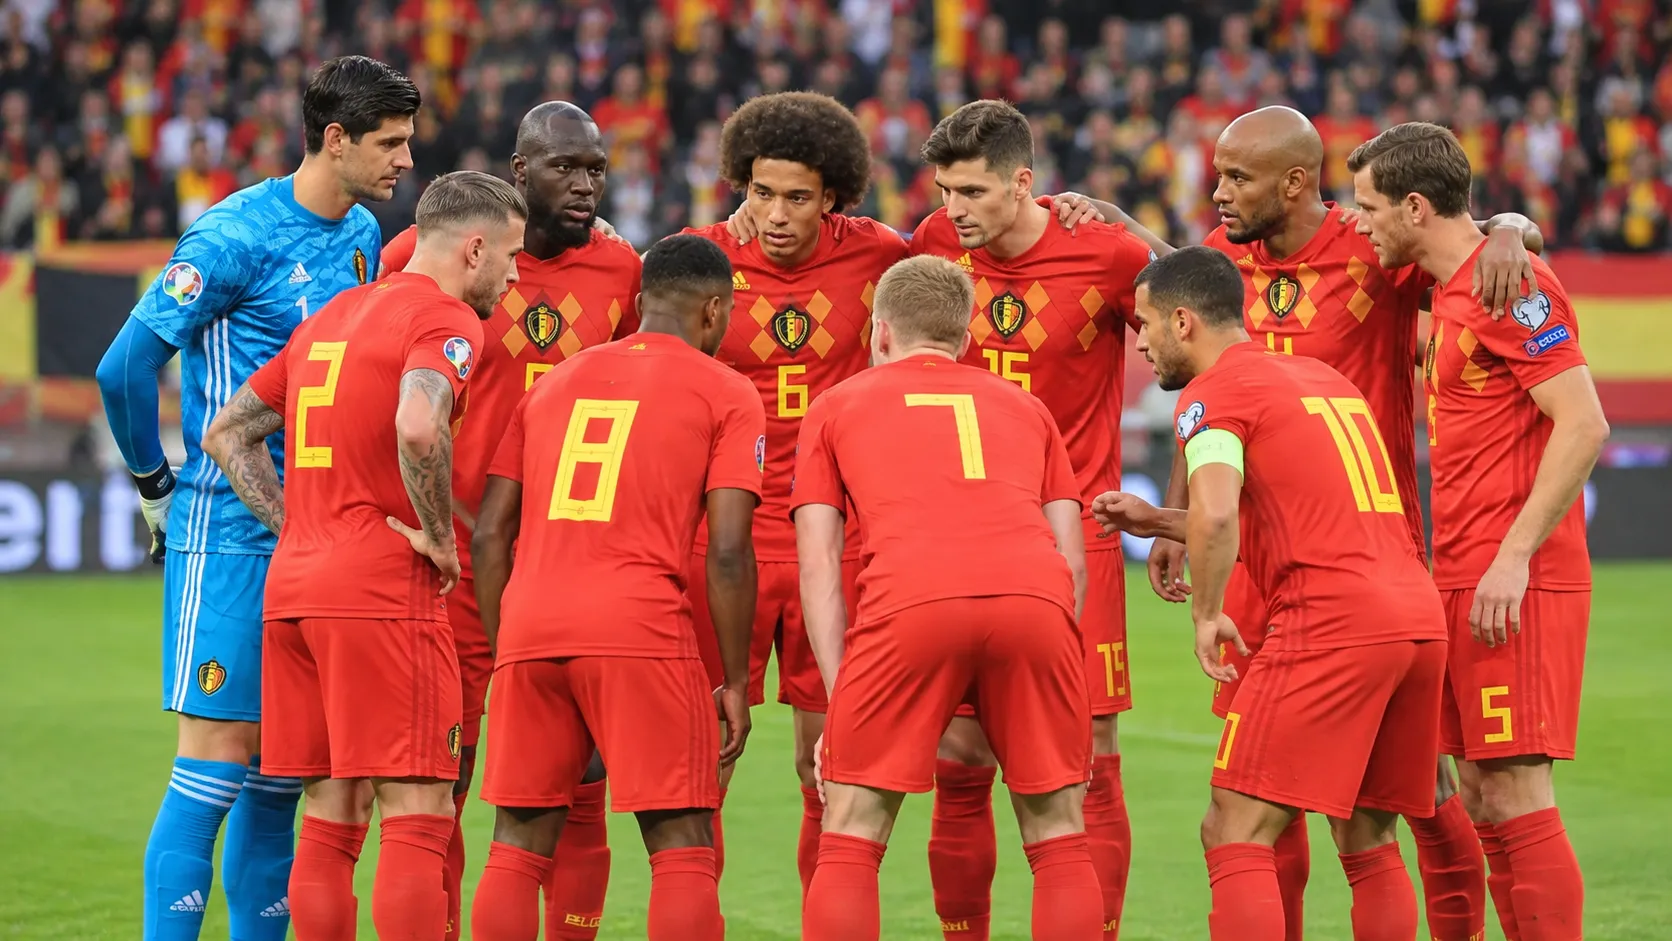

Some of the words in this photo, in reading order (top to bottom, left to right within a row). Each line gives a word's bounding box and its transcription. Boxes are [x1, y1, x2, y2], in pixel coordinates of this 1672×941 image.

[295, 341, 348, 468] 2
[777, 364, 809, 418] 6
[982, 348, 1031, 393] 15
[547, 398, 639, 522] 8
[904, 393, 986, 480] 7
[1300, 396, 1404, 515] 10
[1481, 685, 1513, 743] 5
